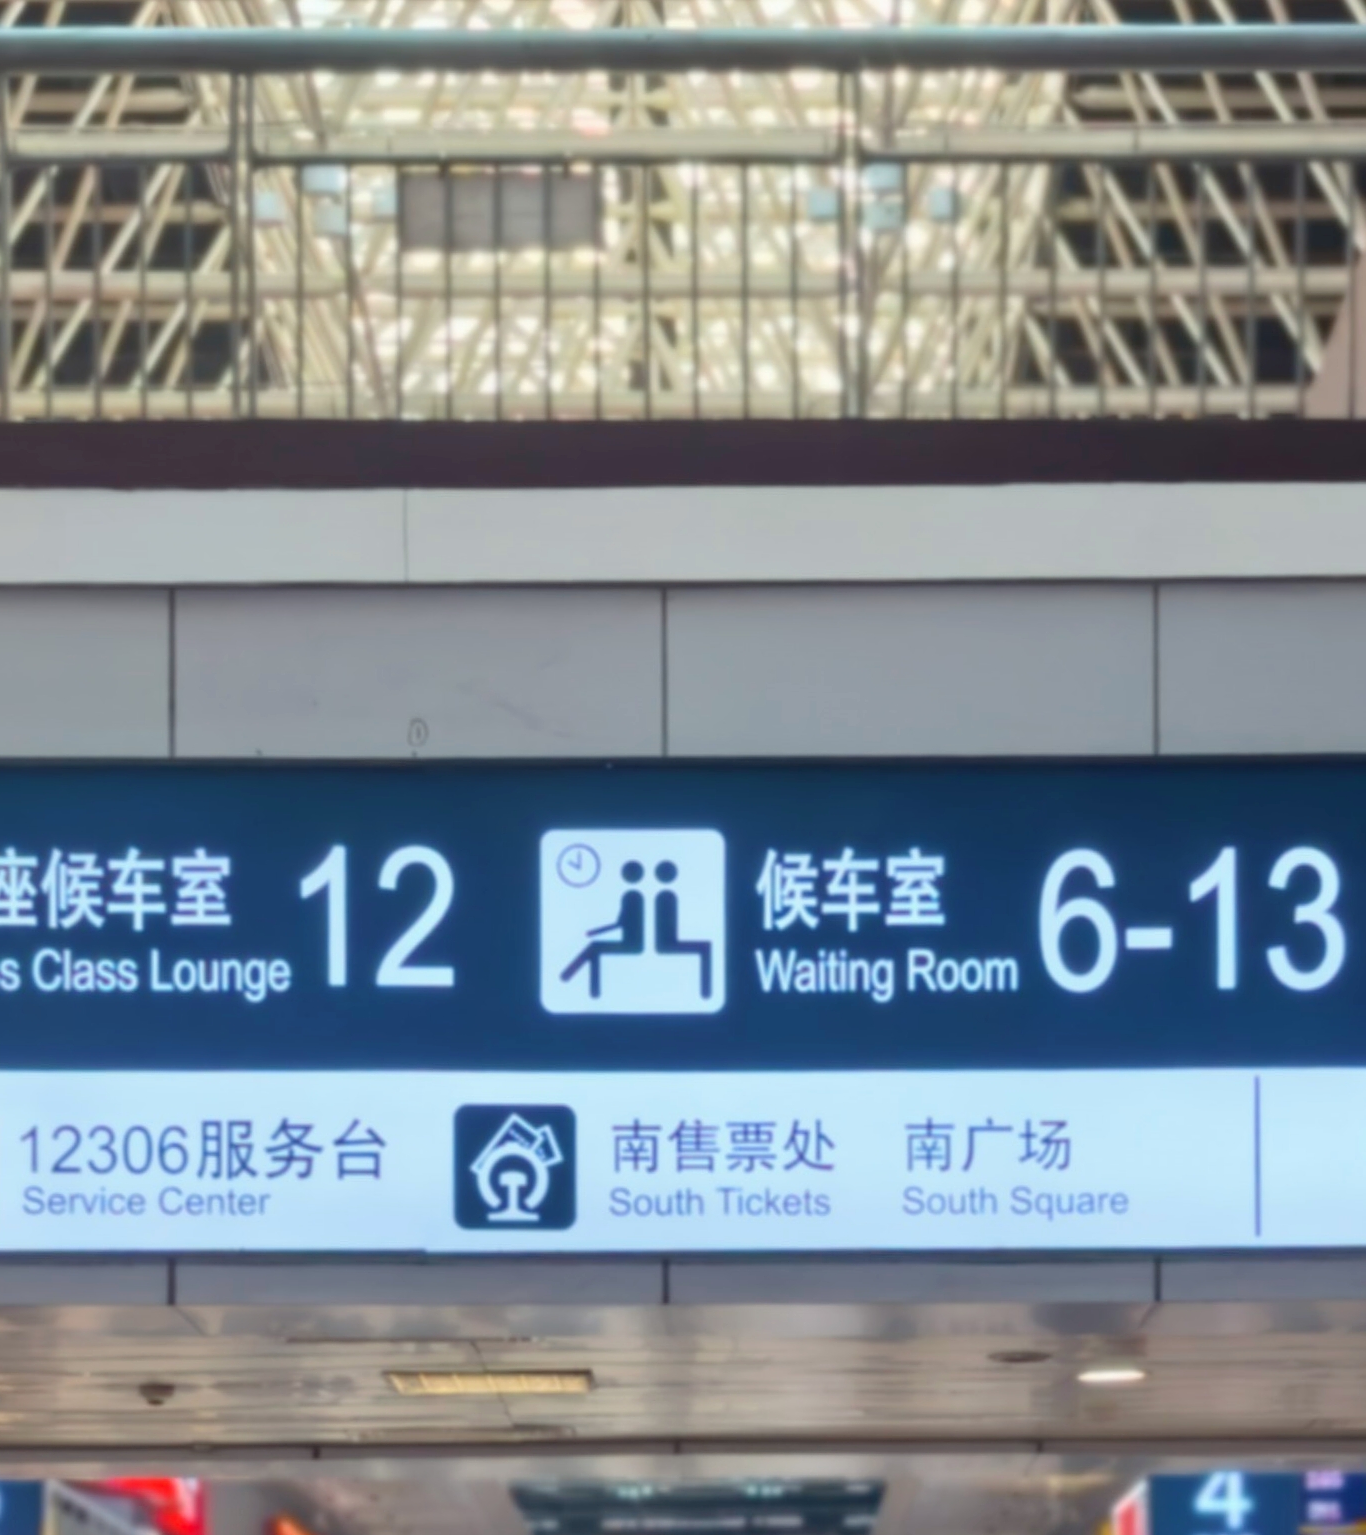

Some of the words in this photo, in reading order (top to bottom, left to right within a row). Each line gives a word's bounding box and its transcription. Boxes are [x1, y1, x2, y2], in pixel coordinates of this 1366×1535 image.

[299, 844, 455, 988] 12
[755, 847, 946, 933] 候车室
[1038, 845, 1347, 994] 6-13
[31, 947, 139, 993] Class
[150, 948, 292, 1004] Lounge
[754, 948, 895, 1004] Waiting
[907, 947, 1019, 992] Room
[21, 1117, 386, 1181] 12306服务台
[612, 1118, 835, 1174] 南售票处
[905, 1117, 1072, 1173] 南广场
[22, 1185, 147, 1216] Service
[157, 1185, 271, 1217] Center
[608, 1186, 702, 1218] South
[716, 1186, 832, 1217] Tickets
[901, 1185, 999, 1217] South
[1009, 1185, 1130, 1223] Square
[1193, 1470, 1254, 1530] 4
